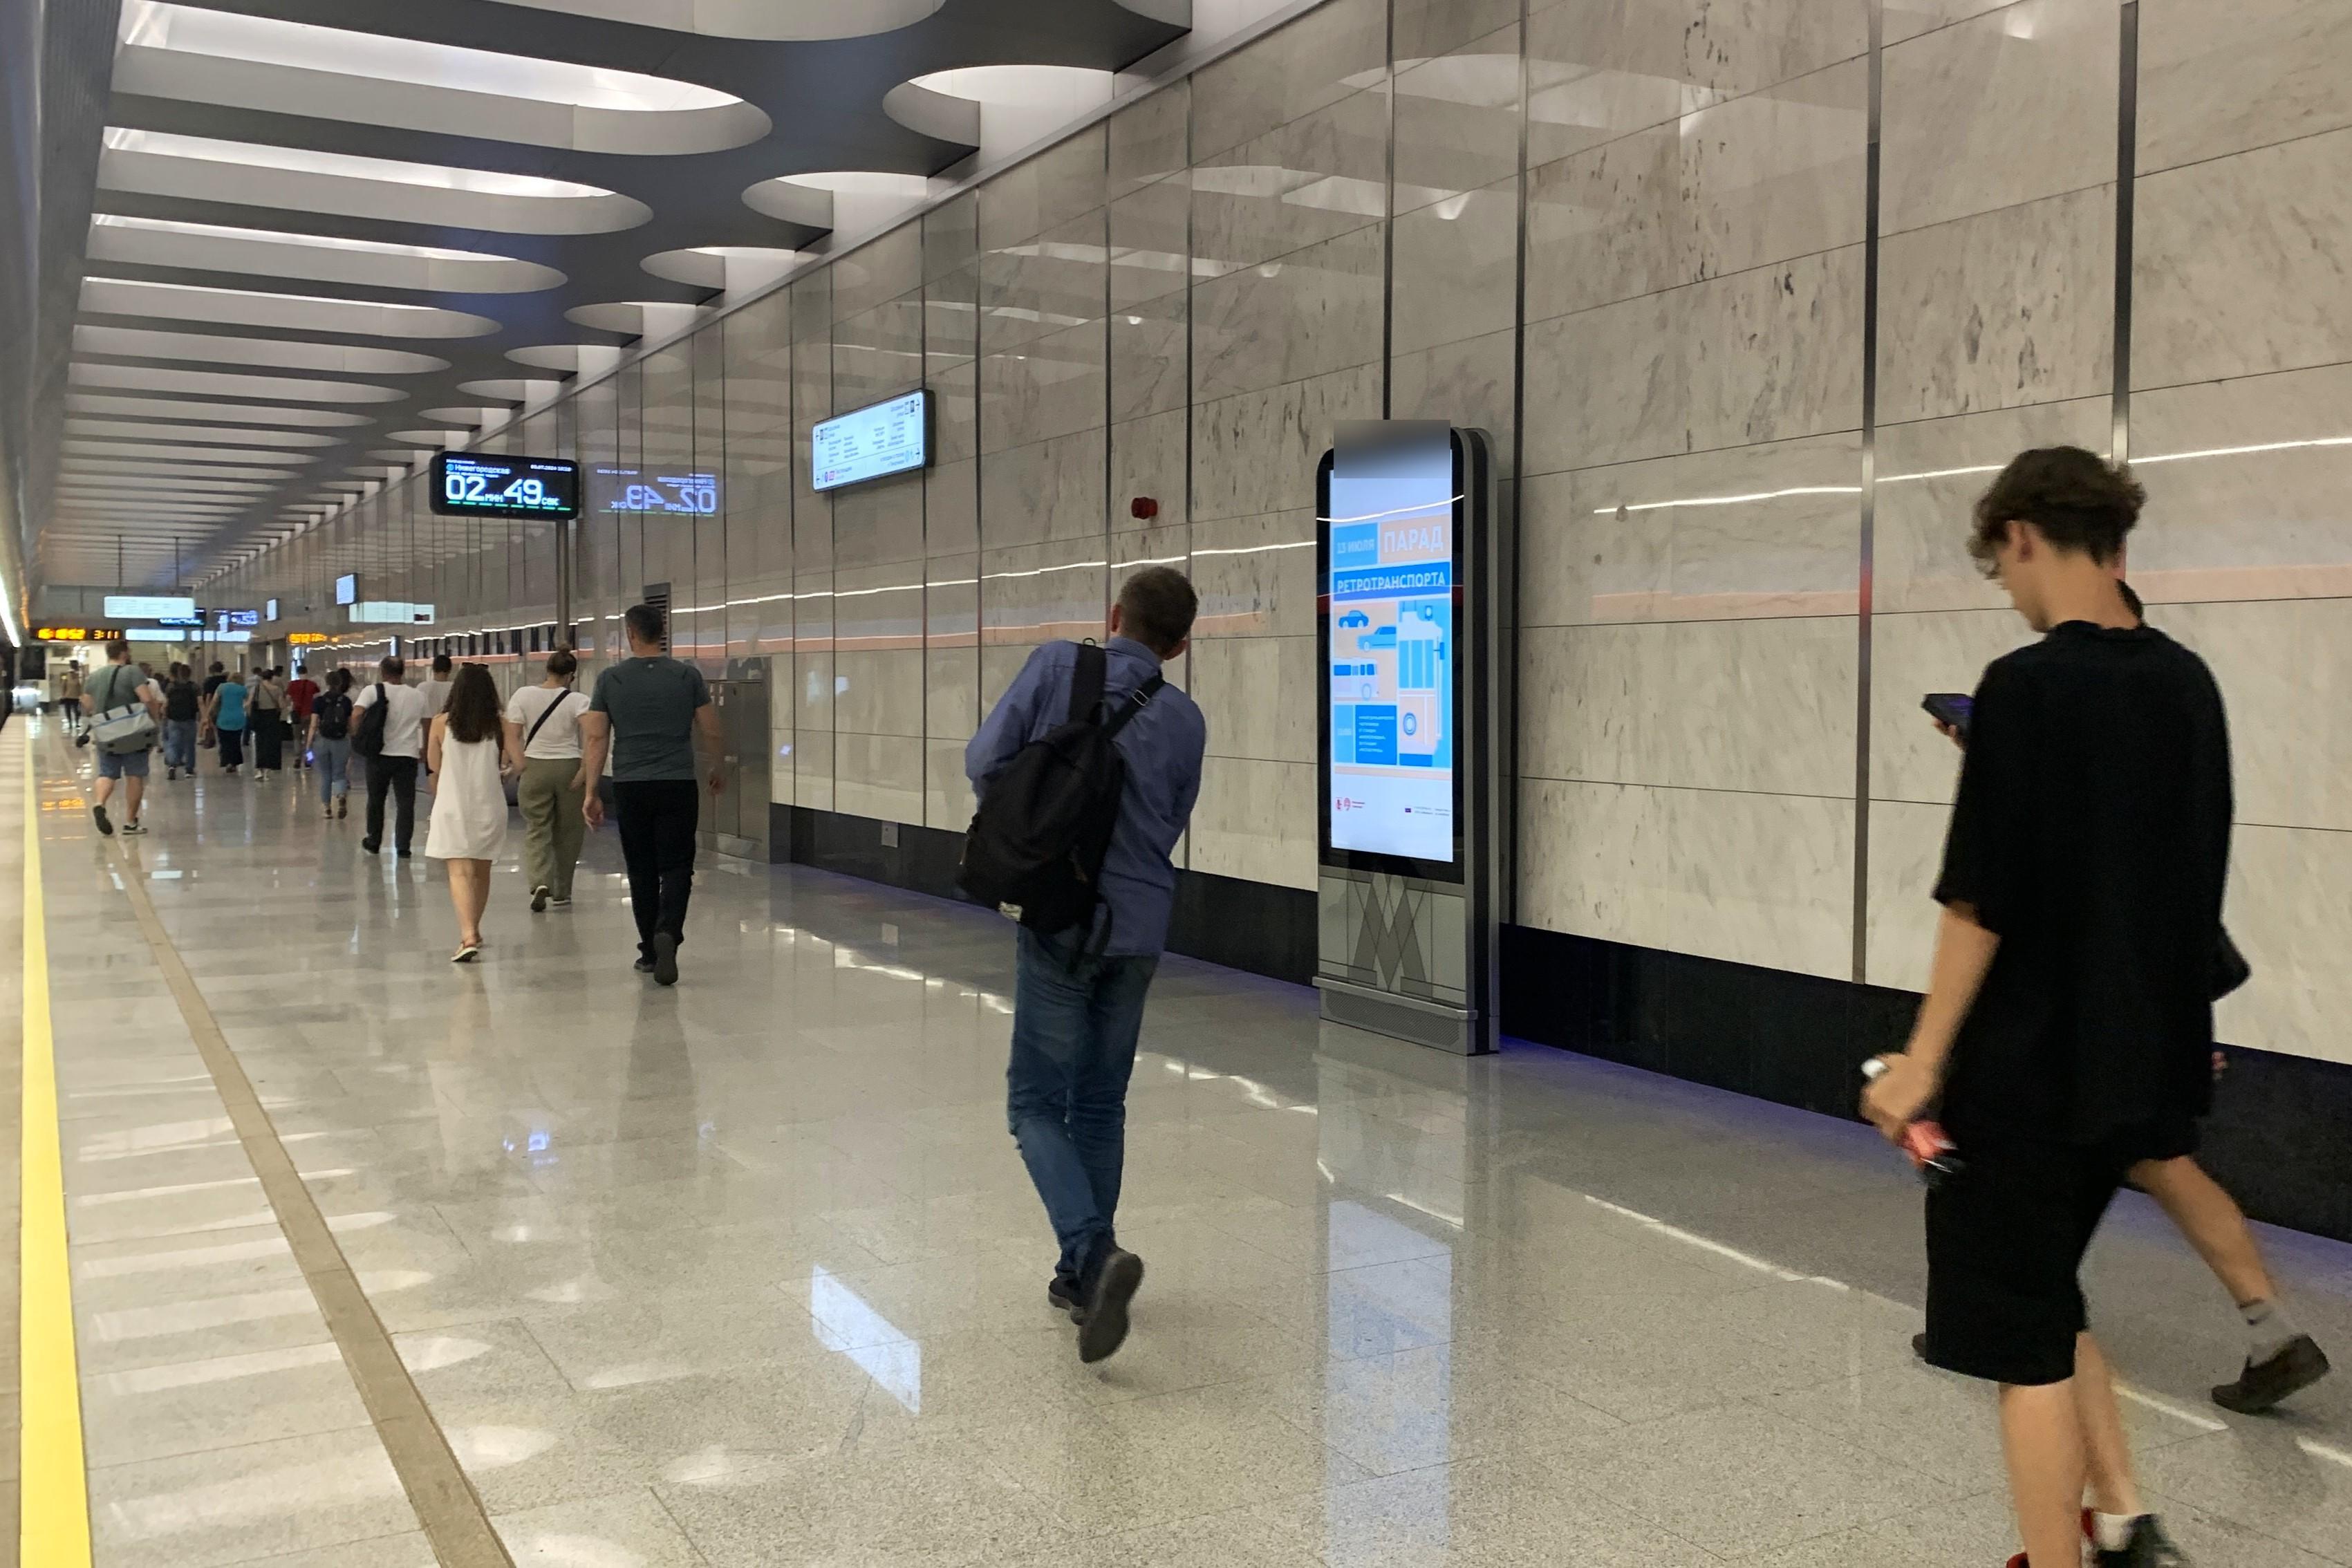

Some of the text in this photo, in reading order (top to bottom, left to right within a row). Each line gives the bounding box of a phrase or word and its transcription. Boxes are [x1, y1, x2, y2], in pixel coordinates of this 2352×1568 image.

[446, 475, 486, 501] 02
[503, 478, 541, 505] 49
[1348, 539, 1374, 553] ИЮЛЯ
[1384, 525, 1444, 552] ПАРАД
[1337, 572, 1445, 592] РЕТРОТРАНСПОРТА
